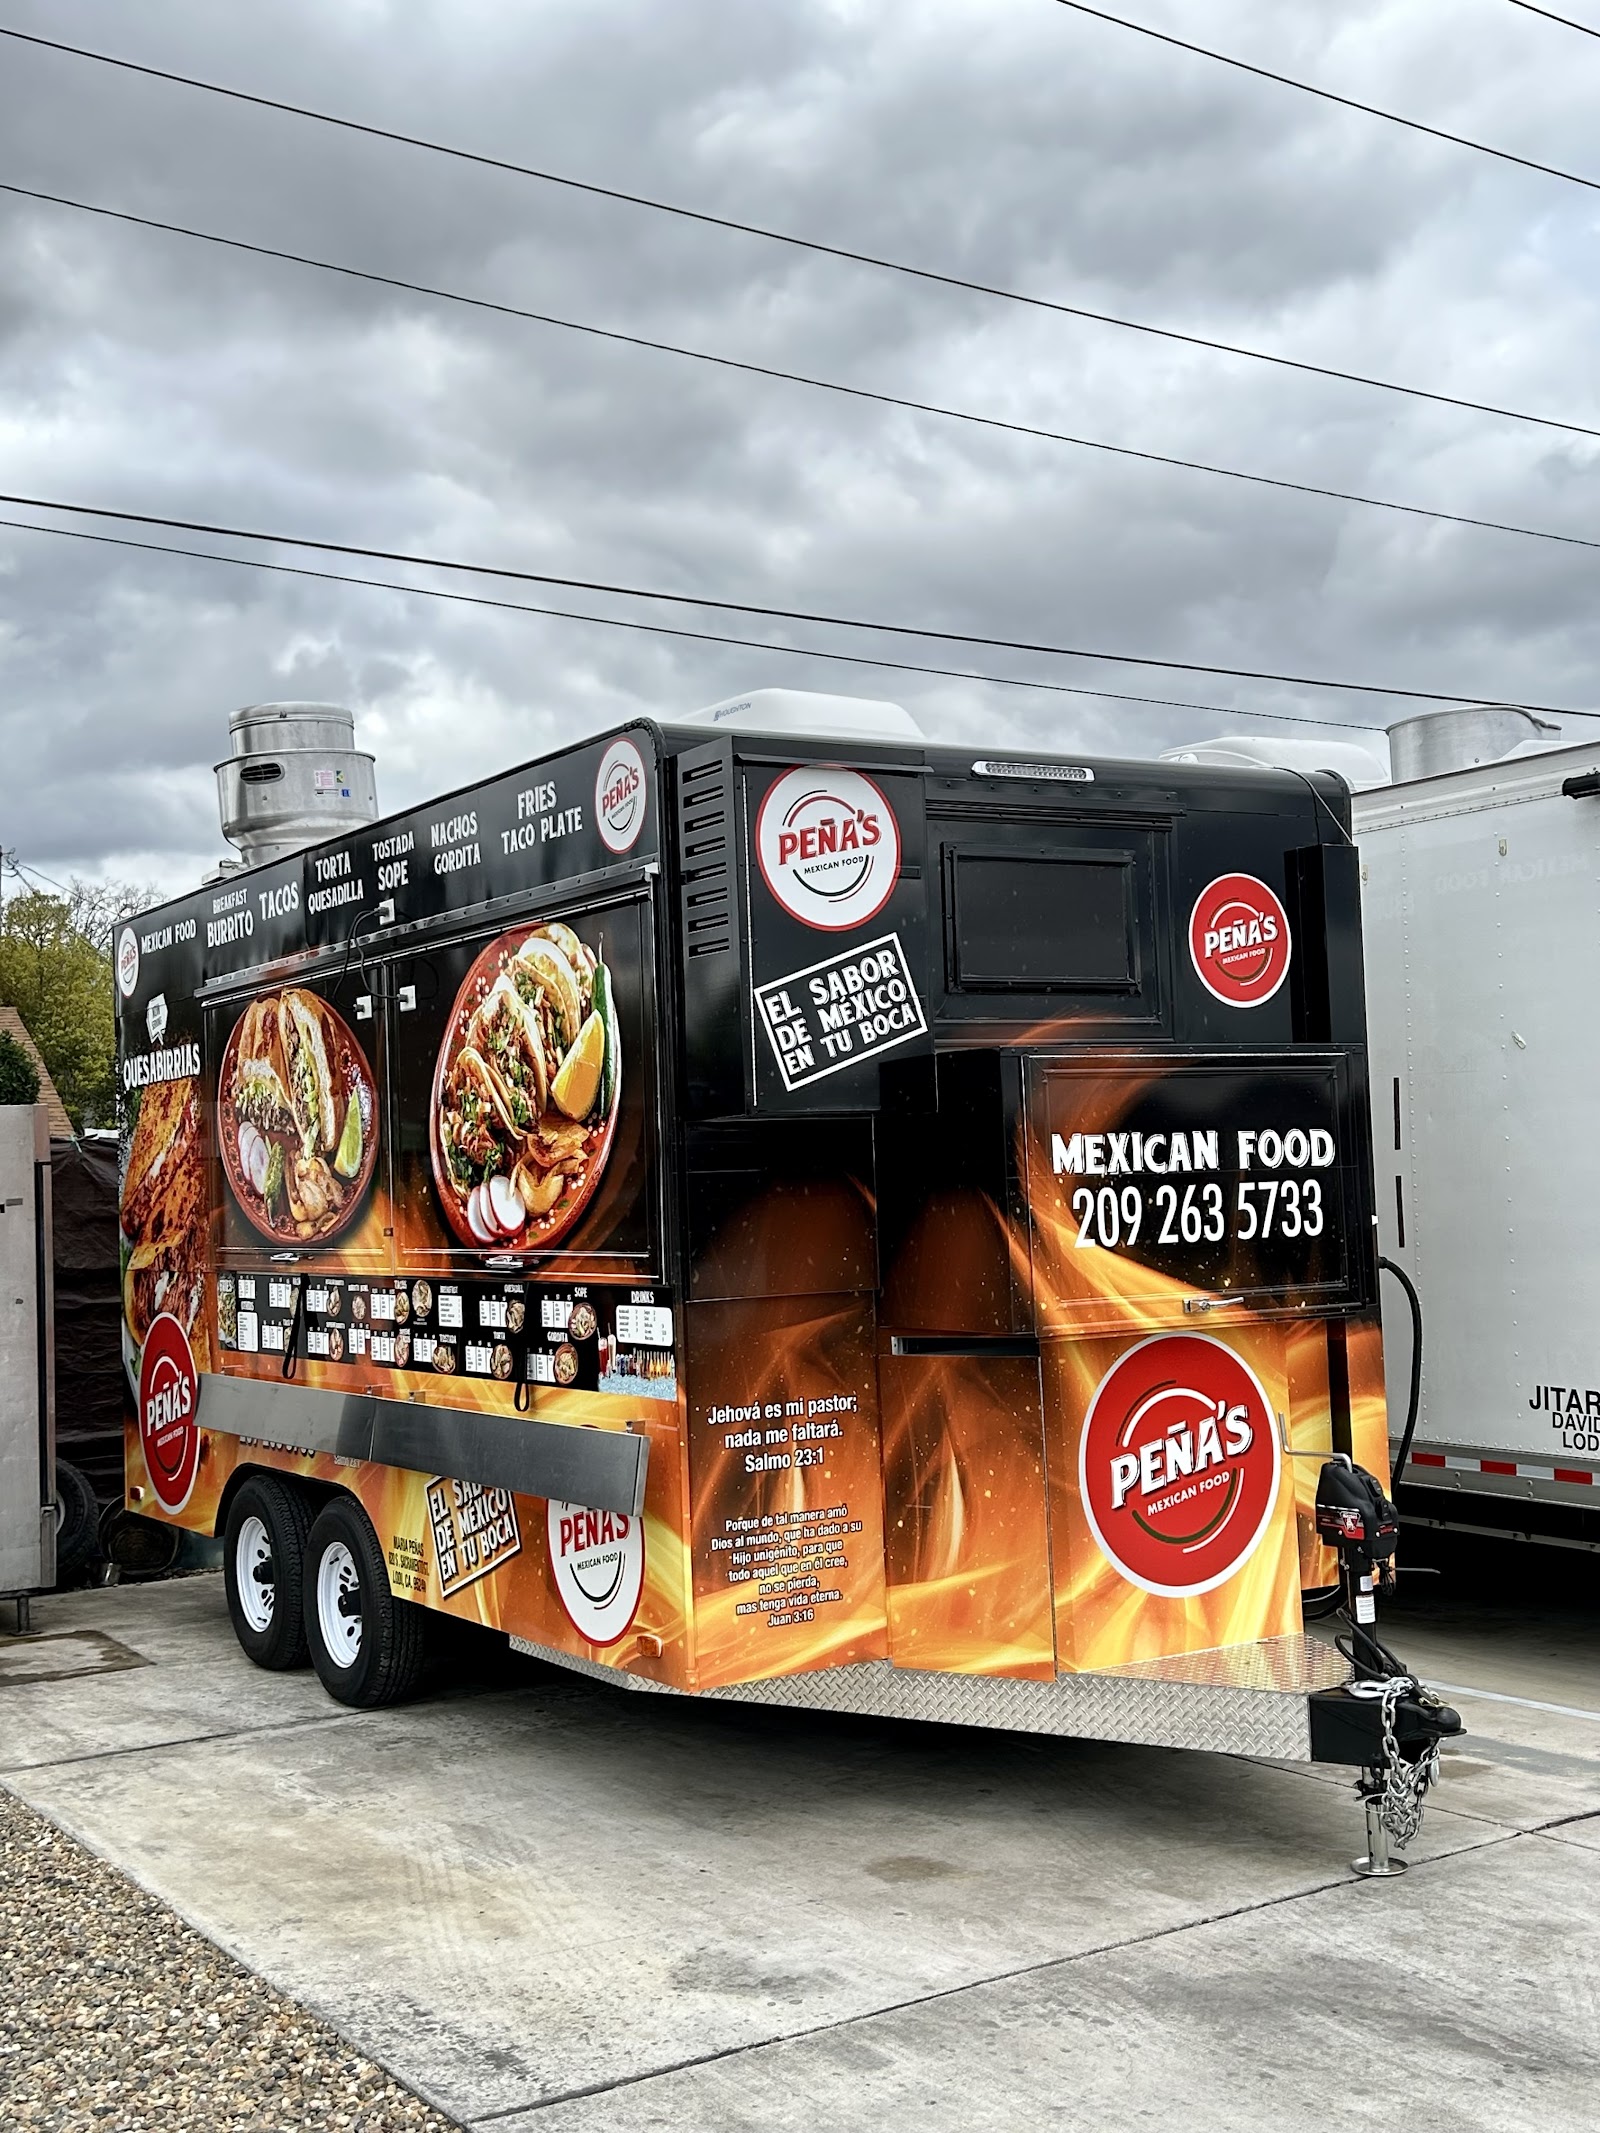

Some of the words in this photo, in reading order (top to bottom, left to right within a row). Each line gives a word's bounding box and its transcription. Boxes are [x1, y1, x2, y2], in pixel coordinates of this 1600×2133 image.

[517, 781, 557, 820] FRIES
[372, 831, 414, 862] TOSTADA
[431, 811, 478, 847] NACHOS
[501, 823, 535, 855] TACO
[540, 806, 583, 843] PLATE
[779, 809, 882, 865] PEÑA'S
[315, 851, 351, 883] TORTA
[378, 860, 409, 891] SOPE
[434, 842, 481, 875] GORDITA
[804, 861, 840, 874] MEXICAN
[842, 856, 864, 866] FOOD
[212, 888, 247, 914] BREAKFAST
[258, 881, 300, 921] TACOS
[308, 879, 364, 915] QUESADILLA
[141, 926, 172, 954] MEXICAN
[175, 919, 197, 944] FOOD
[207, 910, 254, 947] BURRITO
[1204, 912, 1278, 958] PEÑA'S
[764, 990, 802, 1025] EL
[809, 949, 901, 1005] SABOR
[774, 1017, 812, 1052] DE
[817, 978, 907, 1033] MÉXICO
[783, 1044, 816, 1075] EN
[820, 1028, 853, 1058] TU
[858, 1002, 917, 1044] BOCA
[123, 1043, 201, 1090] QUESABIRRIAS
[1051, 1130, 1219, 1176] MEXICAN
[1237, 1128, 1336, 1170] FOOD
[1072, 1186, 1142, 1249] 209
[1156, 1183, 1225, 1244] 263
[1237, 1179, 1323, 1240] 5733
[631, 1290, 654, 1304] DRINKS
[146, 1370, 192, 1437] PEÑA'S
[707, 1401, 760, 1425] Jehová
[765, 1404, 782, 1418] es
[786, 1398, 804, 1416] mi
[808, 1394, 857, 1417] pastor;
[1529, 1385, 1600, 1416] JITAR
[725, 1429, 761, 1448] nada
[766, 1430, 788, 1444] me
[792, 1419, 843, 1441] faltará.
[1563, 1431, 1600, 1451] LOD
[745, 1453, 790, 1472] Salmo
[794, 1447, 824, 1466] 23:1
[1110, 1400, 1254, 1510] PEÑA'S
[430, 1488, 449, 1523] EL
[1147, 1485, 1197, 1516] MEXICAN
[1200, 1471, 1230, 1493] FOOD
[436, 1520, 455, 1554] DE
[457, 1488, 508, 1538] MÉXICO
[711, 1538, 733, 1551] Dios
[735, 1535, 744, 1547] al
[746, 1531, 781, 1546] mundo,
[784, 1530, 801, 1542] que
[803, 1527, 815, 1538] ha
[818, 1523, 840, 1536] dado
[842, 1523, 848, 1532] a
[851, 1521, 862, 1531] su
[726, 1518, 759, 1532] Porque
[761, 1516, 773, 1527] de
[776, 1512, 788, 1525] tal
[790, 1510, 825, 1523] manera
[827, 1505, 847, 1518] amó
[441, 1550, 457, 1580] EN
[459, 1536, 477, 1569] TU
[480, 1514, 514, 1557] BOCA
[577, 1557, 601, 1570] MEXICAN
[603, 1552, 618, 1564] FOOD
[732, 1552, 751, 1565] Hijo
[803, 1544, 823, 1556] para
[826, 1540, 843, 1553] que
[729, 1570, 750, 1582] todo
[753, 1565, 778, 1580] aquel
[781, 1564, 799, 1576] que
[801, 1562, 812, 1571] en
[825, 1557, 847, 1568] cree,
[759, 1584, 771, 1595] no
[773, 1582, 785, 1592] se
[787, 1575, 820, 1592] pierda,
[736, 1603, 757, 1615] mas
[760, 1599, 786, 1611] tenga
[788, 1594, 808, 1606] vida
[811, 1590, 843, 1603] eterna.
[768, 1614, 791, 1626] Juan
[794, 1609, 814, 1622] 3:16
